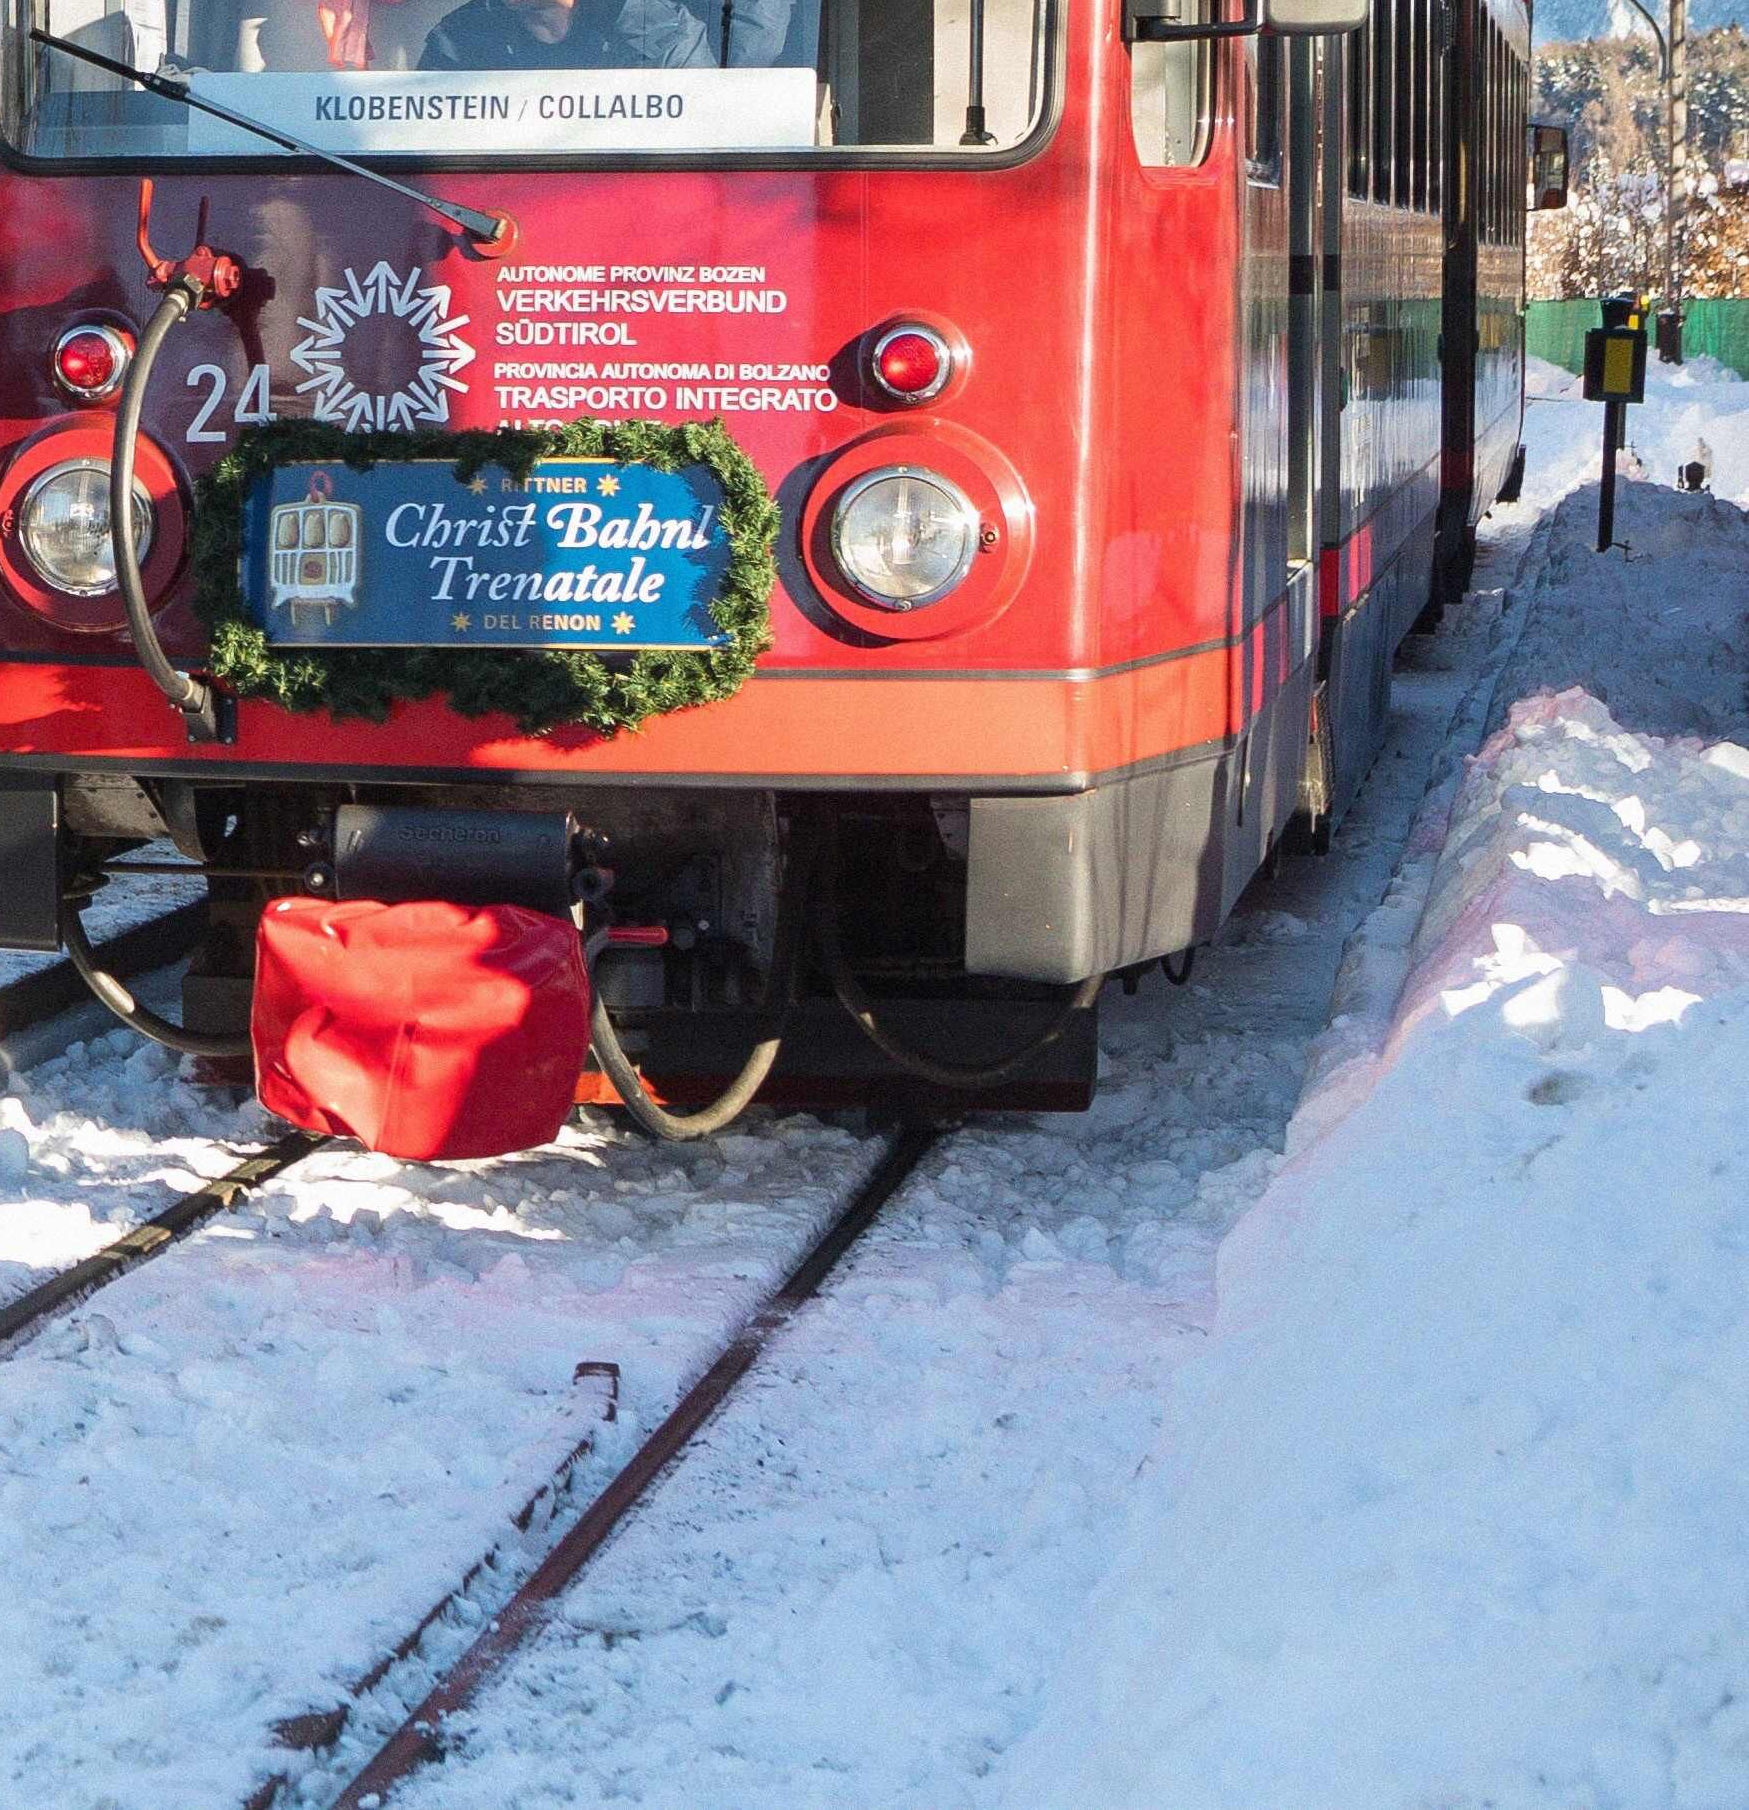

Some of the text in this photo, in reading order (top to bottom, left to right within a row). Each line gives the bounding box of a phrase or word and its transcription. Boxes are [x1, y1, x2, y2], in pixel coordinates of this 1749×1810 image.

[314, 94, 510, 121] KLOBENSTEIN
[539, 92, 685, 121] COLLALBO
[497, 266, 766, 283] AUTONOME PROVINZ BOZEN
[497, 289, 787, 314] VERKEHRSVERBUND
[495, 318, 637, 346] SÜDTIROL
[494, 363, 831, 382] PROVINCIA AUTONOMA DI BOLZANO
[185, 363, 278, 443] 24
[494, 386, 839, 412] TRASPORTO INTEGRATO
[384, 501, 536, 549] Christ
[428, 555, 665, 604] Trenatale
[483, 613, 602, 632] DEL RENON
